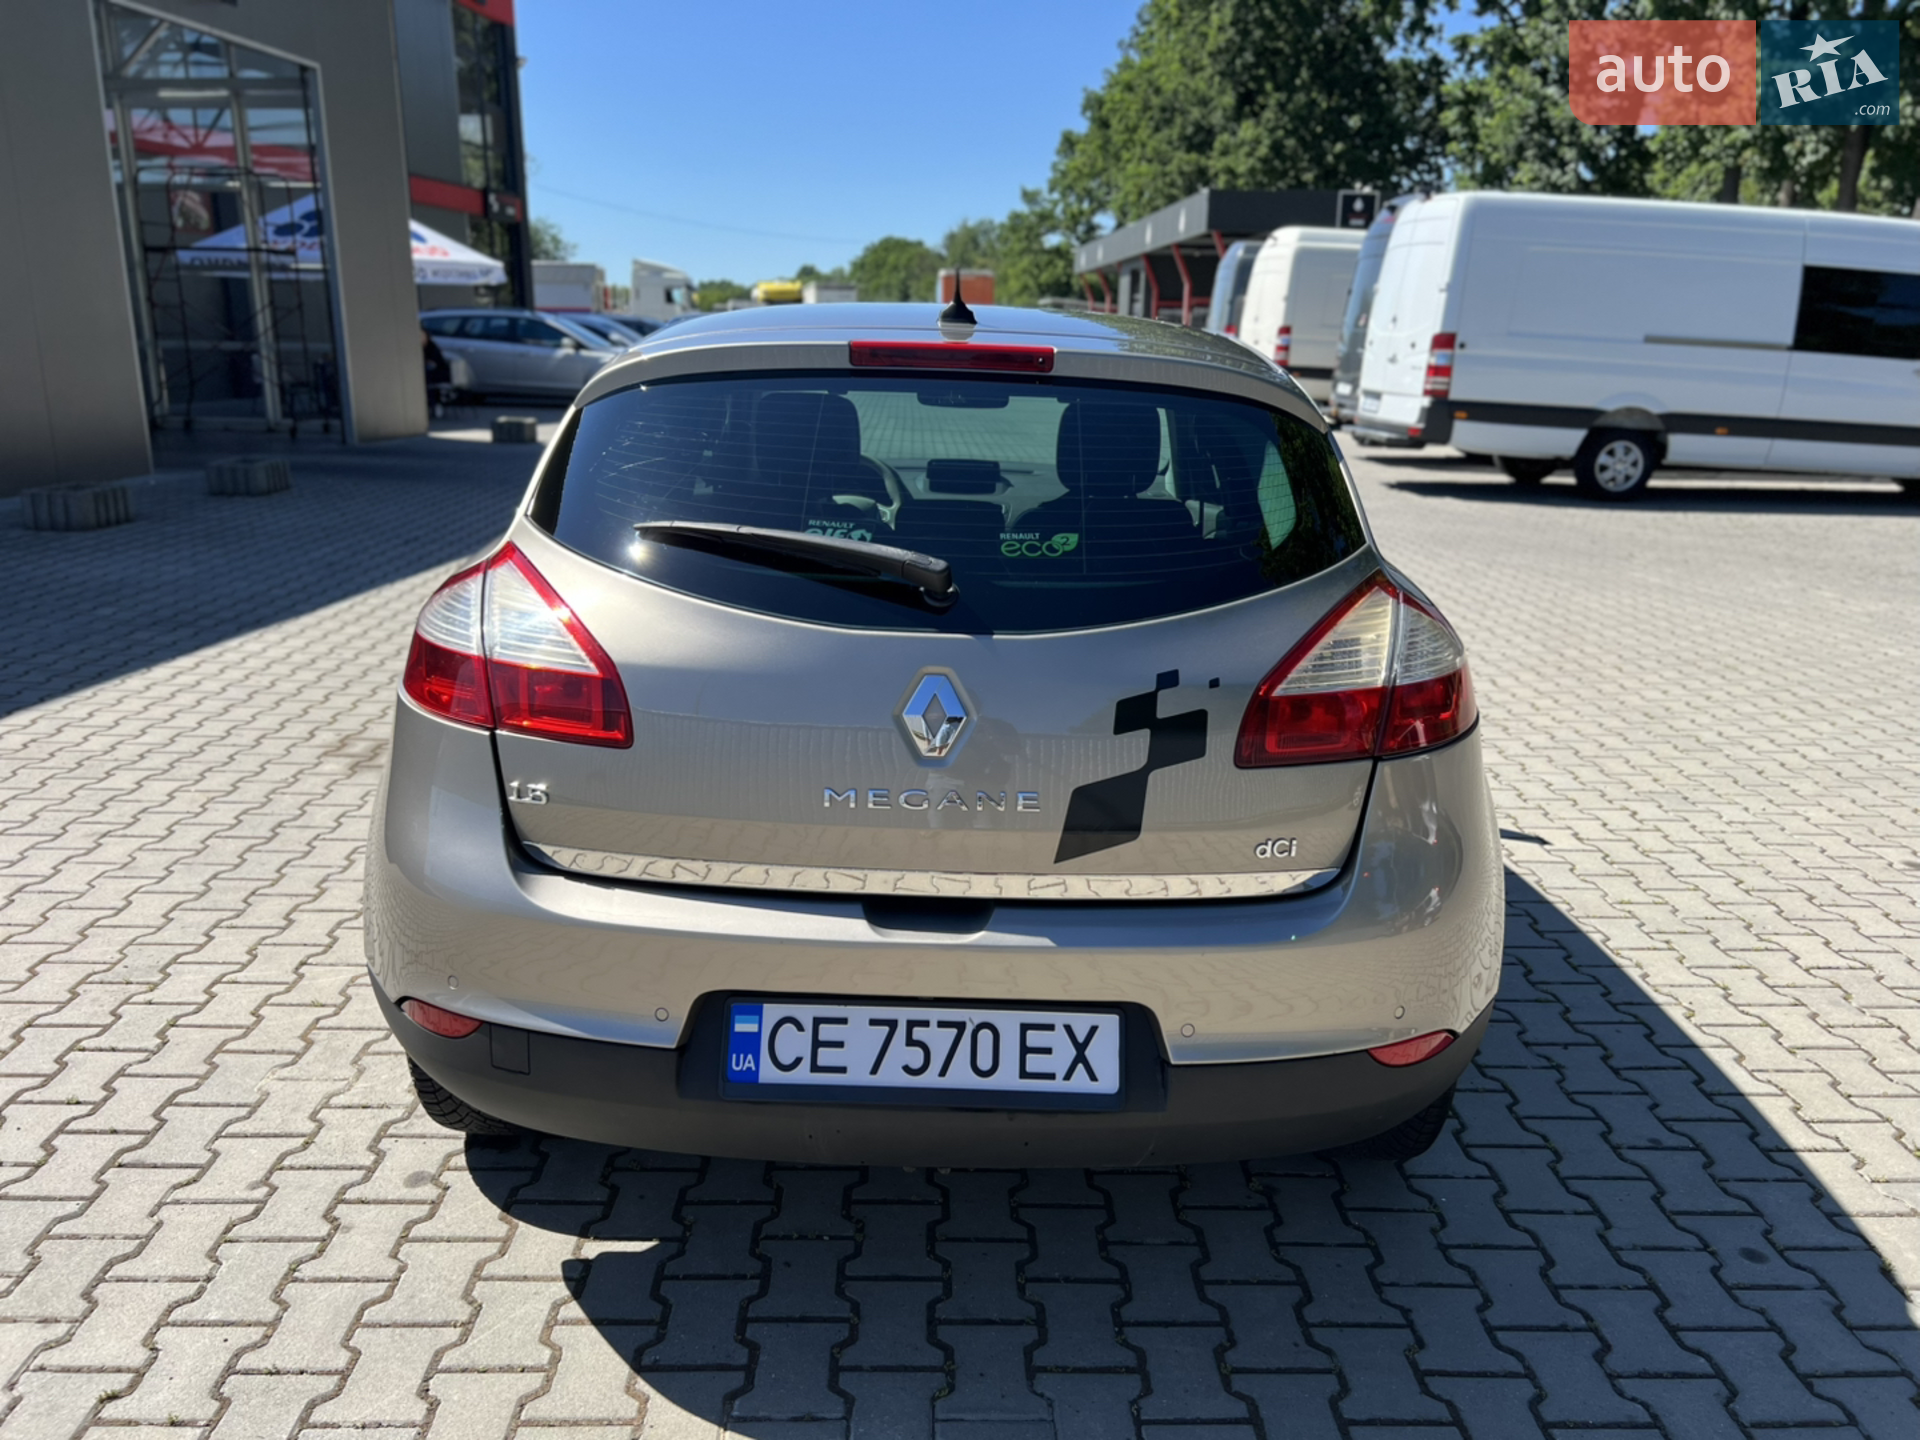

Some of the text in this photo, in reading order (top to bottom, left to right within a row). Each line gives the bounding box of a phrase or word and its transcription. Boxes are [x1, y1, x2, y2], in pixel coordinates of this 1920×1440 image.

[808, 519, 856, 529] RENAULT
[1000, 532, 1040, 540] RENAULT
[823, 786, 1041, 812] MEGANE
[1255, 838, 1297, 858] dCi
[768, 1015, 1100, 1082] CE 7570 EX
[731, 1053, 756, 1071] UA
